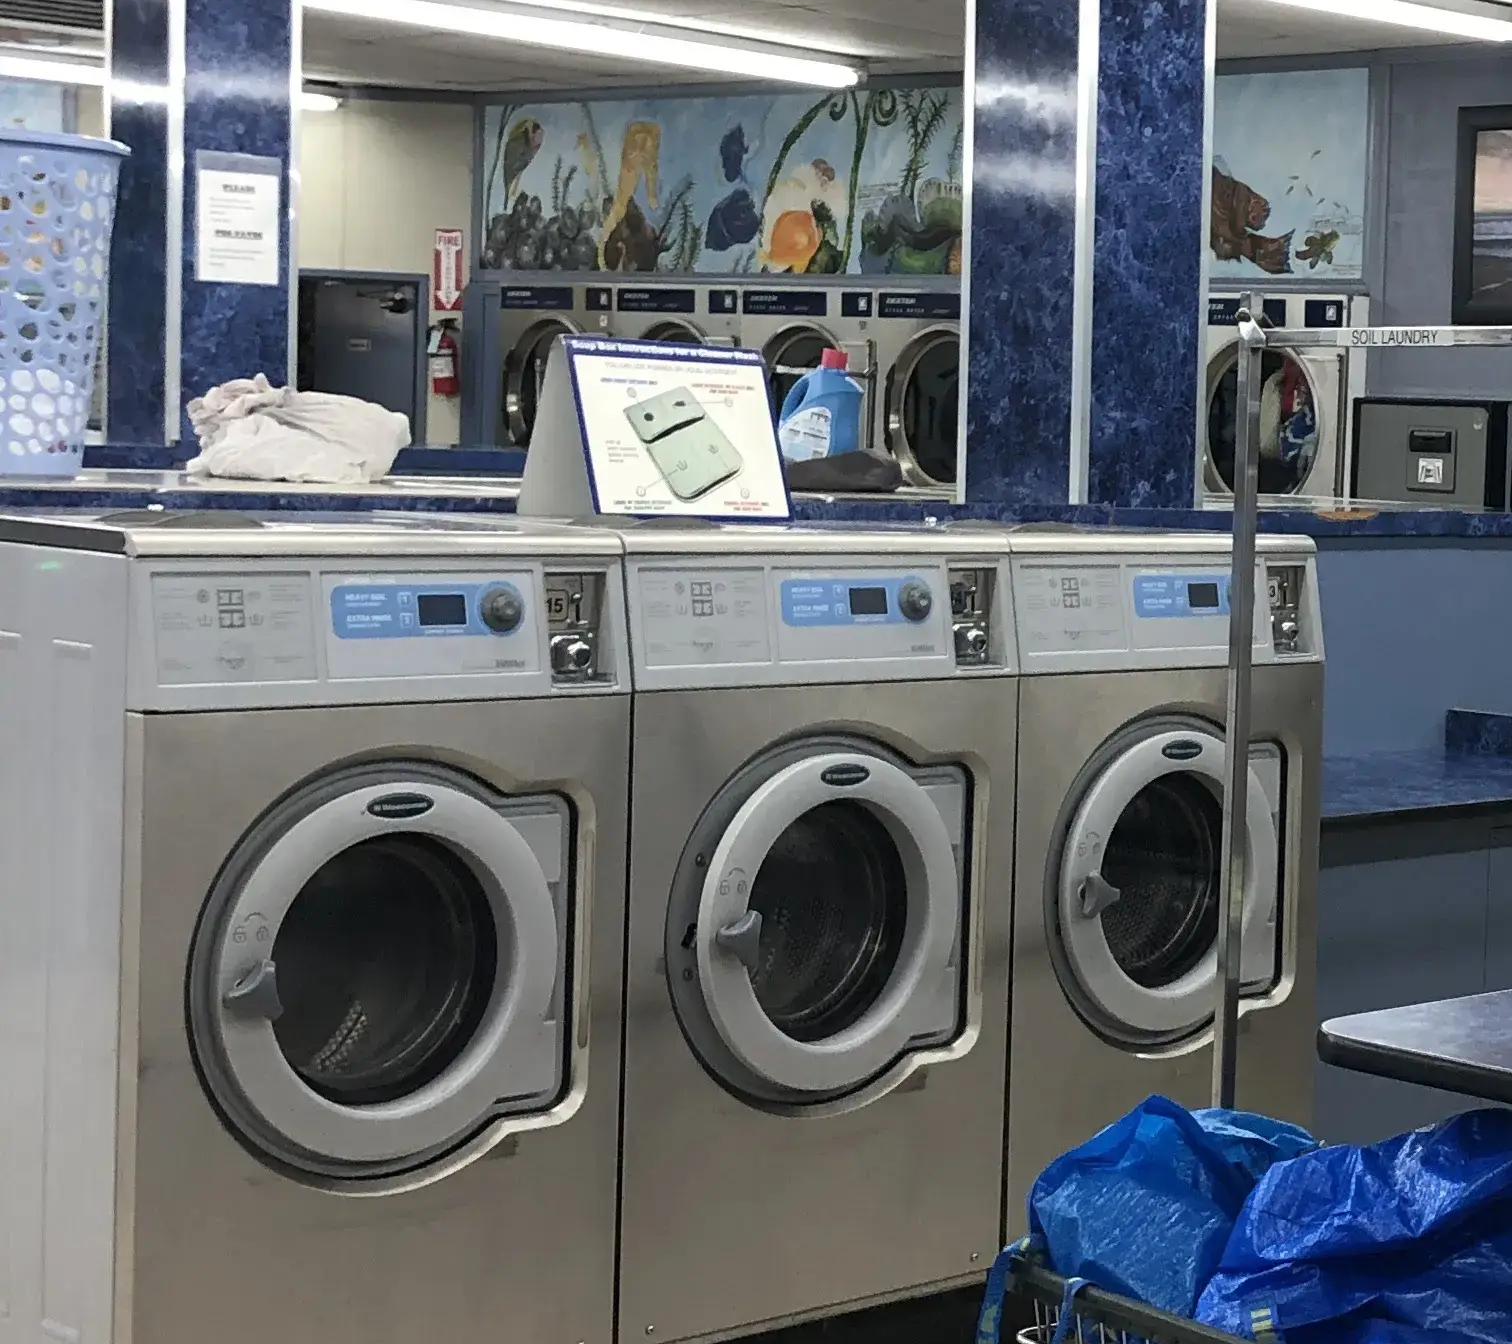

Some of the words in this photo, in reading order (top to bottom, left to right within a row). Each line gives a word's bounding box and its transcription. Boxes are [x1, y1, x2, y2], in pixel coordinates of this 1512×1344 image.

[438, 235, 460, 246] FIRE
[1352, 330, 1378, 344] SOIL
[1382, 329, 1438, 344] LAUNDRY
[545, 598, 563, 613] 15
